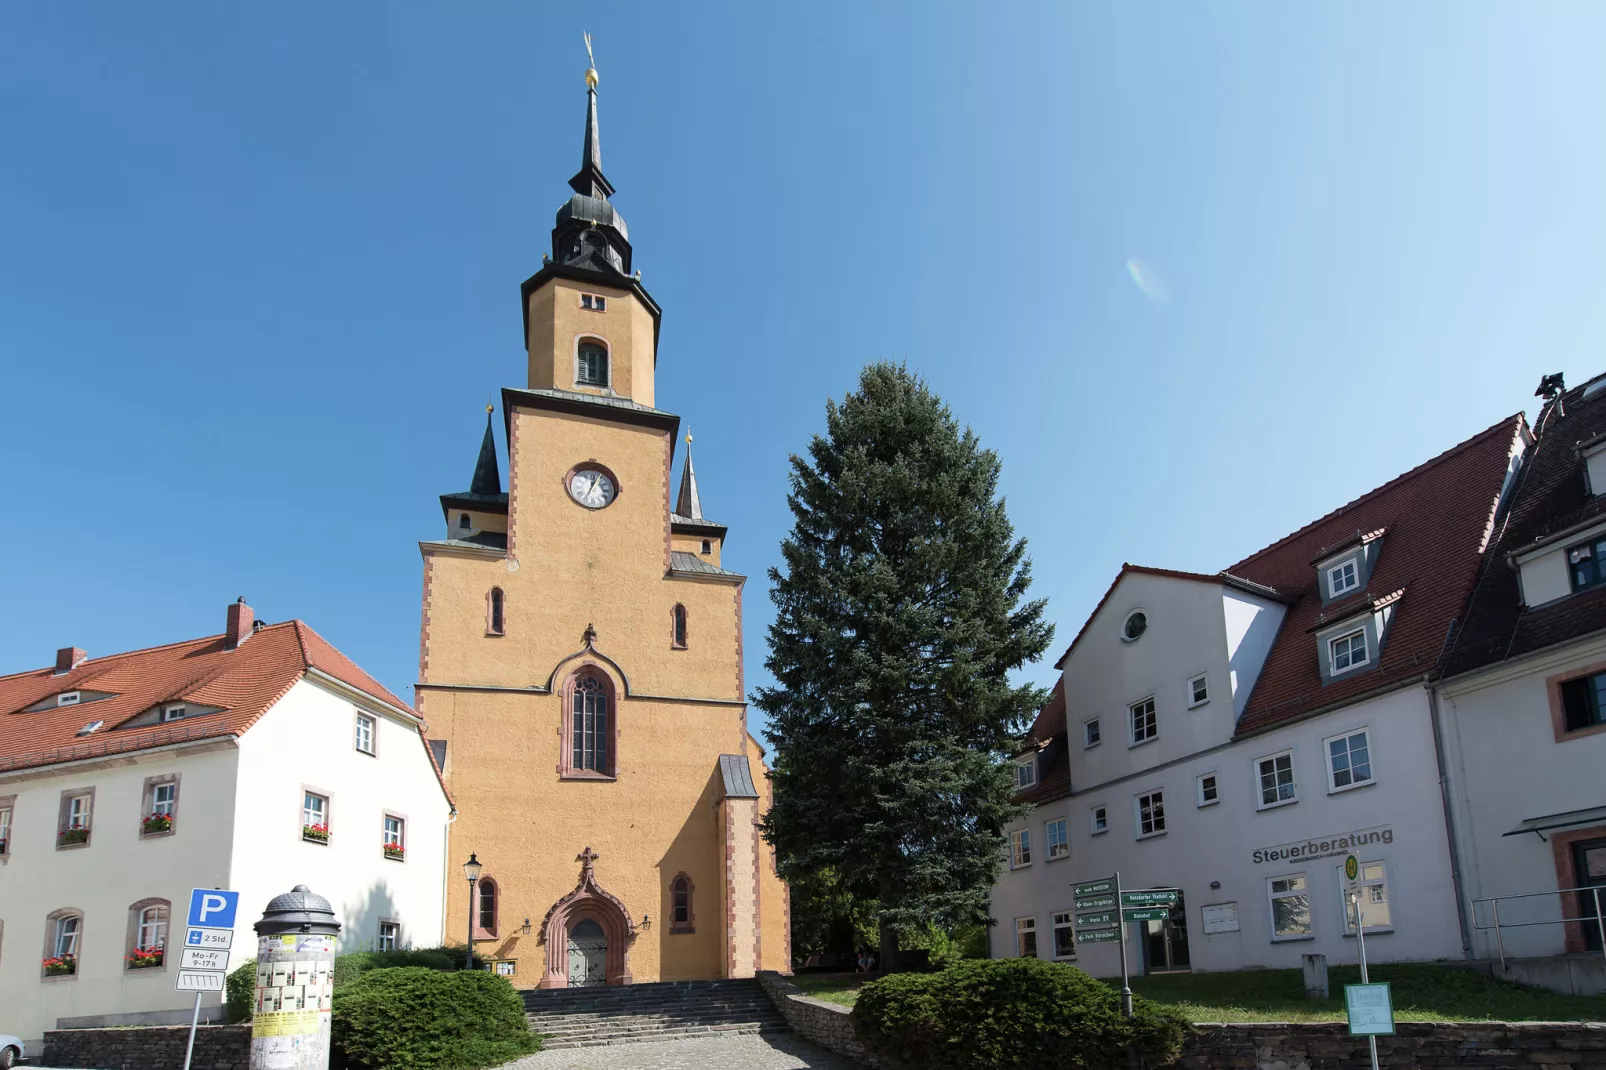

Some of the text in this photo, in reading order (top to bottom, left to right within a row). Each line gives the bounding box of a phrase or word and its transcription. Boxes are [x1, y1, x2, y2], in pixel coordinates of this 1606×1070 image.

[1252, 829, 1394, 864] Steuerberatung
[199, 894, 227, 922] P
[211, 935, 227, 943] Std.
[191, 952, 219, 960] Mo-Fr
